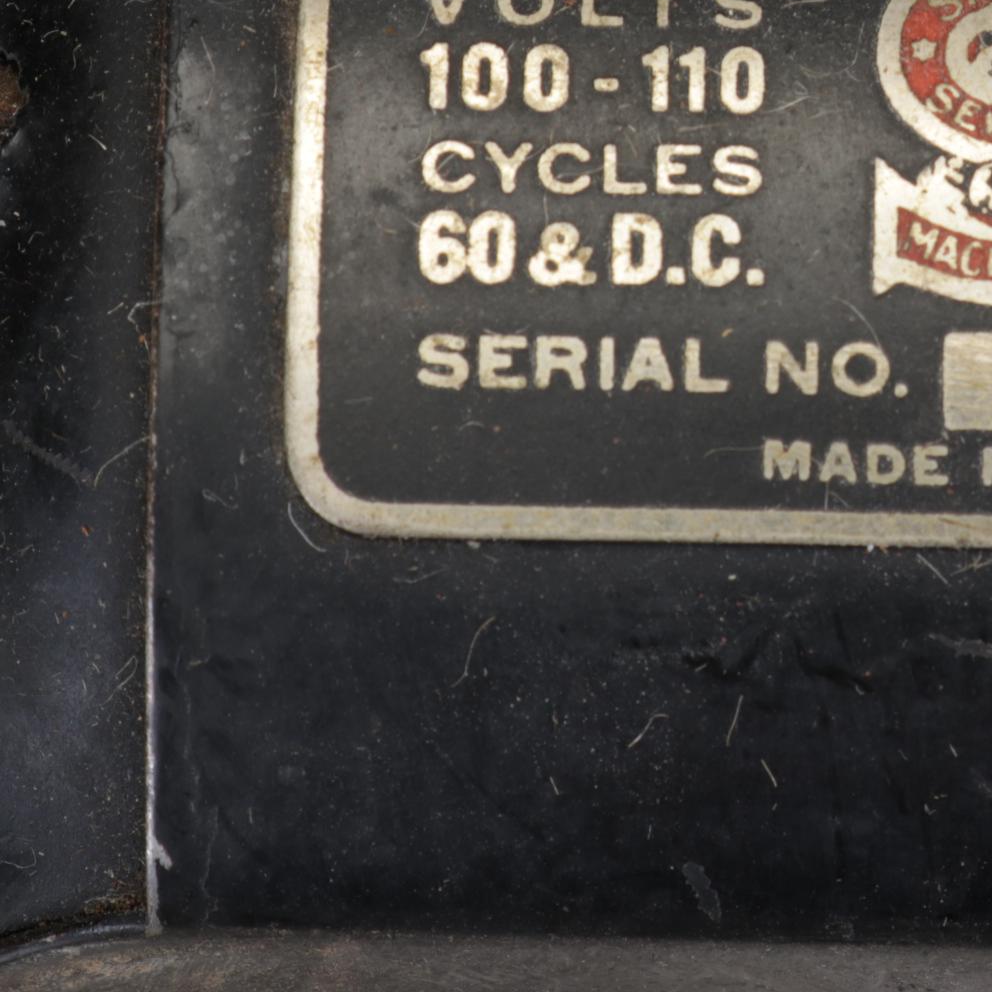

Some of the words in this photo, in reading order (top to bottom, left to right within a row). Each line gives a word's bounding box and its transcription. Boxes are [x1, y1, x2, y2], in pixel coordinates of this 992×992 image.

[419, 140, 764, 195] CYCLES
[417, 210, 517, 285] 60
[611, 211, 766, 287] D.C.
[416, 333, 730, 392] SERIAL
[765, 339, 909, 397] NO.
[762, 437, 950, 488] MADE
